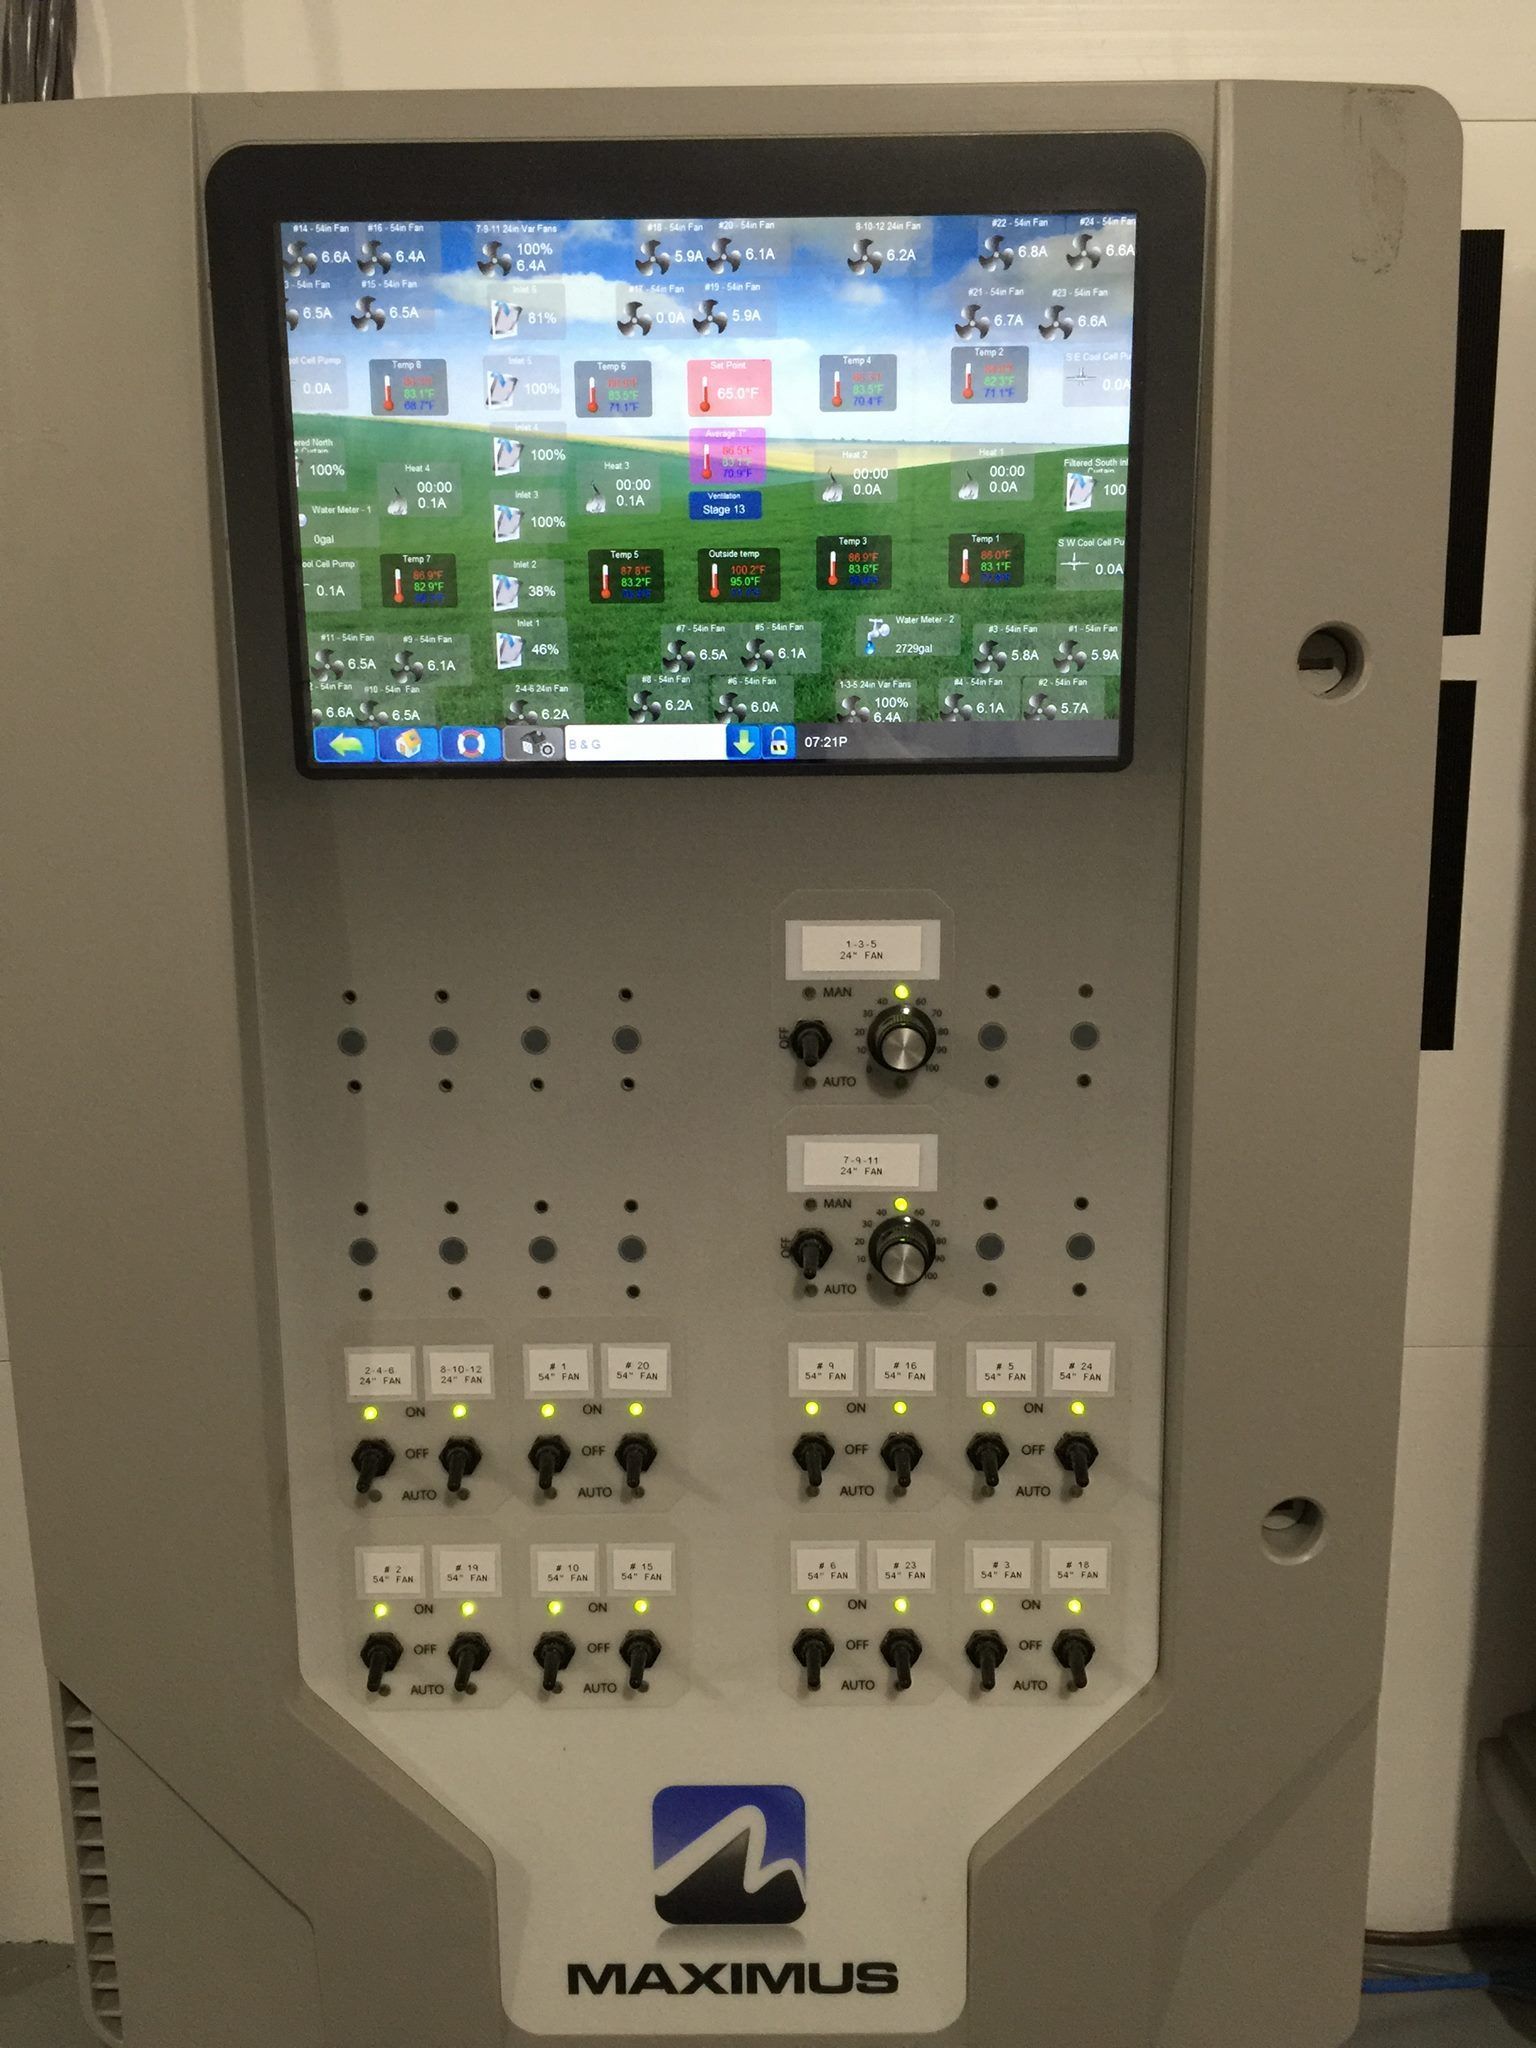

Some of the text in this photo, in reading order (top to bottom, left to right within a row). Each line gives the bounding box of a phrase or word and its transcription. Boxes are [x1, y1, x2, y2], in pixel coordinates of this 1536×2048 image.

[517, 243, 553, 256] 100%
[745, 248, 775, 260] 6.1A
[1018, 245, 1048, 258] 6.8A
[1106, 244, 1135, 257] 6.6A
[321, 251, 351, 263] 6.6A
[396, 250, 425, 263] 6.4A
[675, 250, 704, 263] 5.9A
[887, 249, 916, 262] 6.2A
[516, 259, 546, 272] 6.4A
[303, 307, 333, 319] 6.5A
[390, 307, 419, 319] 6.5A
[528, 312, 557, 324] 81%
[656, 312, 685, 324] 0.0A
[732, 310, 762, 322] 5.9A
[994, 314, 1024, 327] 6.7A
[1078, 315, 1107, 327] 6.6A
[975, 348, 1004, 358] Temp 2
[843, 356, 872, 366] Temp 4
[303, 383, 332, 394] 0.0A
[525, 382, 560, 395] 100%
[531, 449, 566, 461] 100%
[842, 451, 868, 459] Heat 2
[979, 448, 1004, 457] Heat 1
[310, 464, 345, 476] 100%
[405, 464, 430, 472] Heat 4
[604, 462, 630, 470] Heat 3
[989, 465, 1025, 477] 00:00
[853, 468, 889, 480] 00:00
[417, 481, 452, 493] 00:00
[616, 479, 651, 491] 00:00
[853, 484, 882, 495] 0.0A
[989, 481, 1018, 493] 0.0A
[533, 491, 539, 499] 3
[418, 497, 447, 509] 0.1A
[616, 495, 645, 507] 0.1A
[703, 504, 746, 517] Stage 13
[531, 516, 566, 528] 100%
[314, 534, 335, 546] 0gal
[839, 537, 867, 547] Temp 3
[972, 535, 1000, 544] Temp 1
[403, 554, 431, 564] Temp 7
[611, 550, 639, 560] Temp 5
[709, 550, 760, 559] Outside temp
[513, 560, 537, 569] Inlet 2
[1095, 563, 1124, 576] 0.0A
[316, 585, 345, 597] 0.1A
[528, 586, 556, 597] 38%
[517, 619, 540, 627] Inlet 1
[532, 643, 559, 655] 46%
[778, 648, 807, 659] 6.1A
[896, 643, 933, 655] 2729gal
[699, 649, 728, 661] 6.5A
[1011, 650, 1039, 662] 5.8A
[1091, 649, 1119, 661] 5.9A
[348, 658, 376, 670] 6.5A
[427, 660, 456, 672] 6.1A
[665, 700, 693, 711] 6.2A
[751, 702, 779, 713] 6.0A
[875, 697, 909, 709] 100%
[976, 702, 1004, 714] 6.1A
[1061, 702, 1089, 714] 5.7A
[326, 707, 354, 719] 6.6A
[392, 709, 420, 722] 6.5A
[541, 709, 570, 721] 6.2A
[874, 711, 902, 724] 6.4A
[569, 740, 577, 750] B
[592, 740, 601, 750] G
[805, 736, 848, 749] 07:21P
[846, 940, 877, 949] 1-3-5
[865, 952, 883, 960] FAN
[823, 987, 852, 998] MAN
[823, 1077, 856, 1087] AUTO
[843, 1156, 879, 1165] 7-9-11
[865, 1168, 883, 1176] FAN
[824, 1199, 852, 1209] MAN
[824, 1284, 857, 1294] AUTO
[365, 1366, 395, 1375] 2-4-6
[440, 1365, 483, 1373] 8-10-12
[637, 1362, 650, 1370] 20
[828, 1362, 835, 1370] 9
[905, 1362, 917, 1370] 16
[383, 1377, 401, 1385] FAN
[465, 1376, 483, 1384] FAN
[562, 1373, 580, 1381] FAN
[640, 1372, 658, 1381] FAN
[829, 1372, 847, 1380] FAN
[908, 1372, 926, 1381] FAN
[1008, 1373, 1026, 1381] FAN
[1083, 1373, 1101, 1381] FAN
[406, 1407, 426, 1418] ON
[582, 1404, 602, 1415] ON
[846, 1403, 866, 1414] ON
[1024, 1403, 1044, 1414] ON
[405, 1448, 430, 1459] OFF
[581, 1446, 606, 1457] OFF
[845, 1444, 869, 1455] OFF
[1021, 1445, 1046, 1456] OFF
[402, 1489, 437, 1500] AUTO
[578, 1487, 612, 1498] AUTO
[840, 1486, 875, 1497] AUTO
[1016, 1486, 1051, 1497] AUTO
[414, 1604, 434, 1615] ON
[588, 1603, 608, 1613] ON
[848, 1599, 867, 1610] ON
[1021, 1600, 1041, 1610] ON
[414, 1644, 437, 1655] OFF
[587, 1643, 611, 1653] OFF
[846, 1640, 869, 1650] OFF
[1019, 1640, 1042, 1651] OFF
[411, 1685, 444, 1695] AUTO
[584, 1683, 618, 1694] AUTO
[841, 1680, 875, 1690] AUTO
[1013, 1680, 1048, 1691] AUTO
[567, 1962, 900, 1996] MAXIMUS
